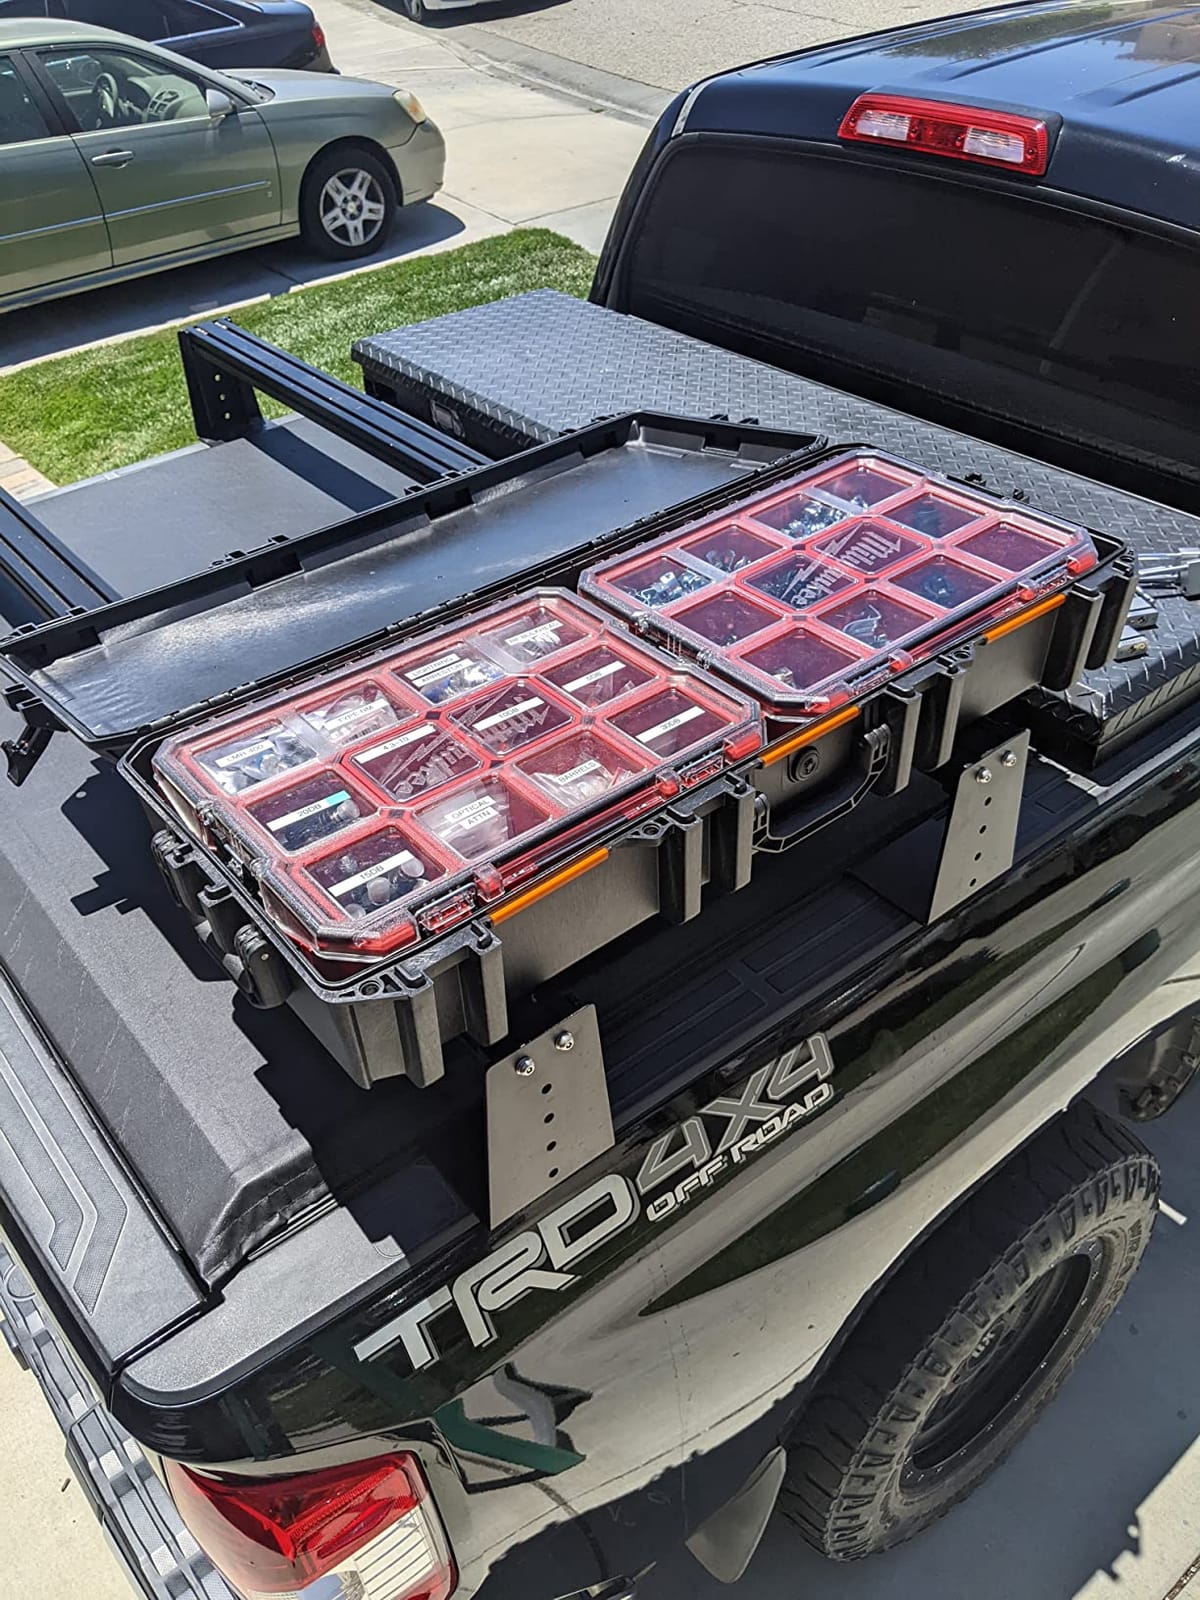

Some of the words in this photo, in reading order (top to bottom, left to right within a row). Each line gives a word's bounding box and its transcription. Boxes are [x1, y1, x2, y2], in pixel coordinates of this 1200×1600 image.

[557, 761, 597, 783] BARRELS
[297, 803, 322, 818] 20DB
[451, 798, 490, 819] OPTICAL
[467, 810, 491, 825] ATTN
[359, 865, 384, 880] 15DB
[646, 1155, 730, 1222] OFF
[730, 1082, 834, 1163] ROAD
[353, 1173, 640, 1370] TRD
